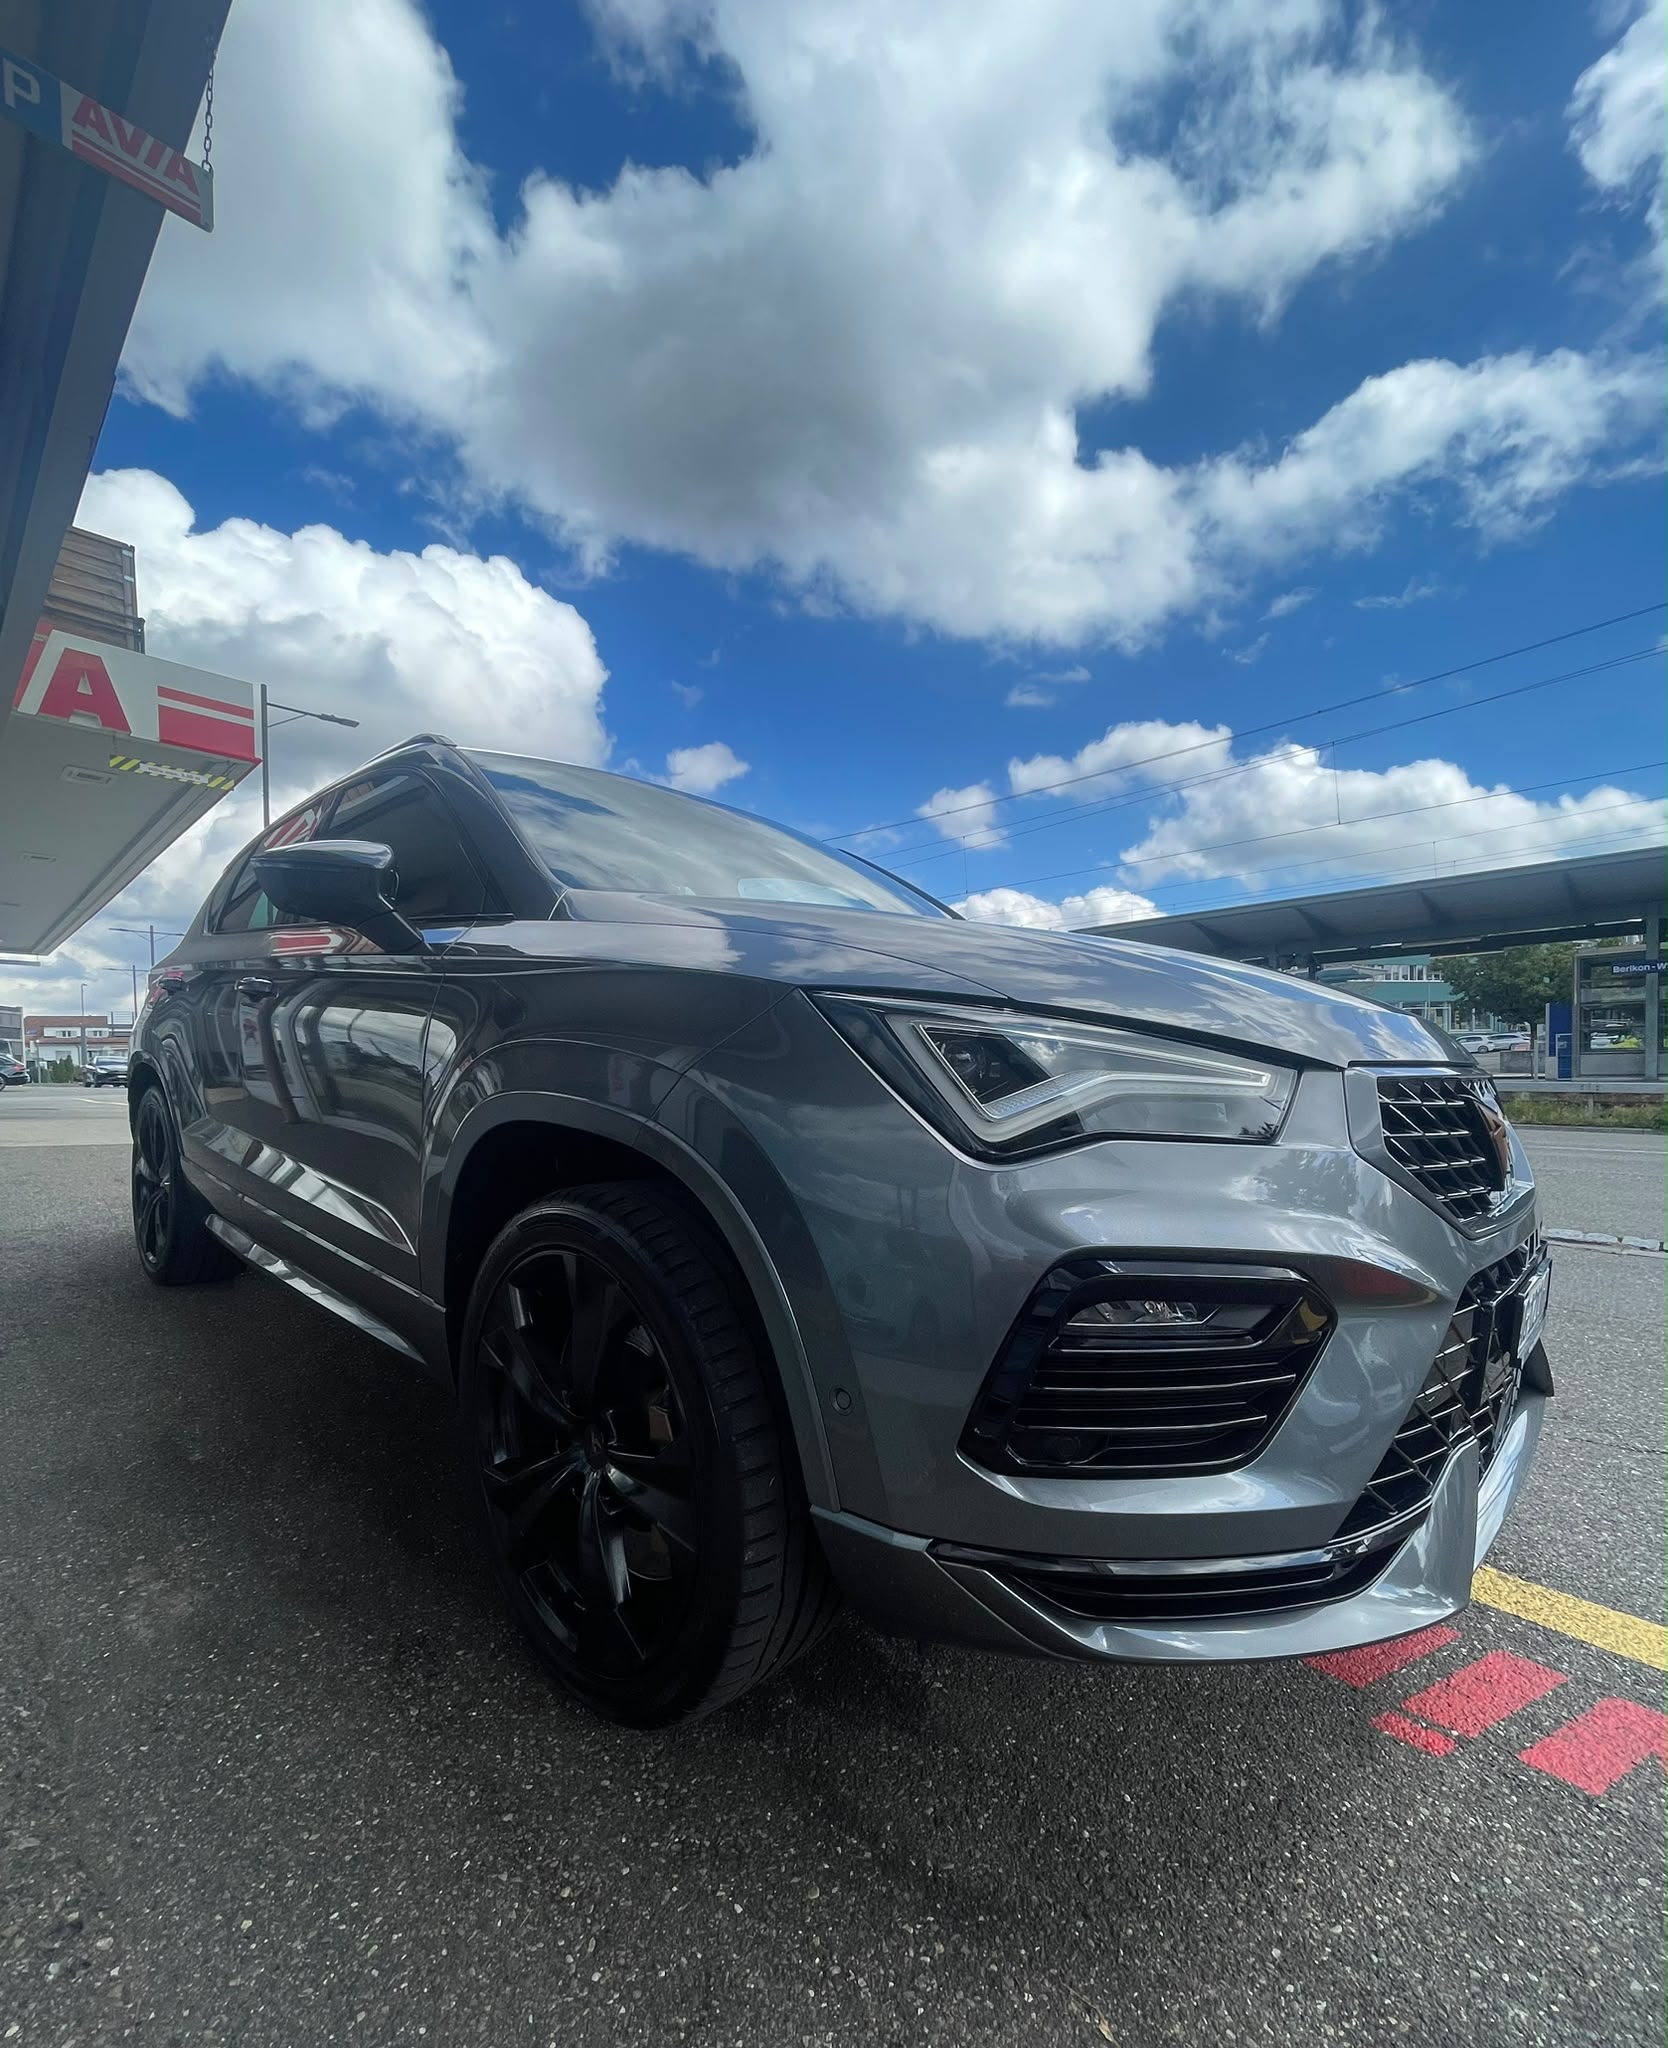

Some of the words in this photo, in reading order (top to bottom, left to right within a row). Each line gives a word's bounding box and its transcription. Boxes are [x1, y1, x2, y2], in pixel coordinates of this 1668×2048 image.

[3, 58, 41, 110] P
[72, 95, 200, 197] AVIA
[1612, 962, 1668, 974] Berikon-W
